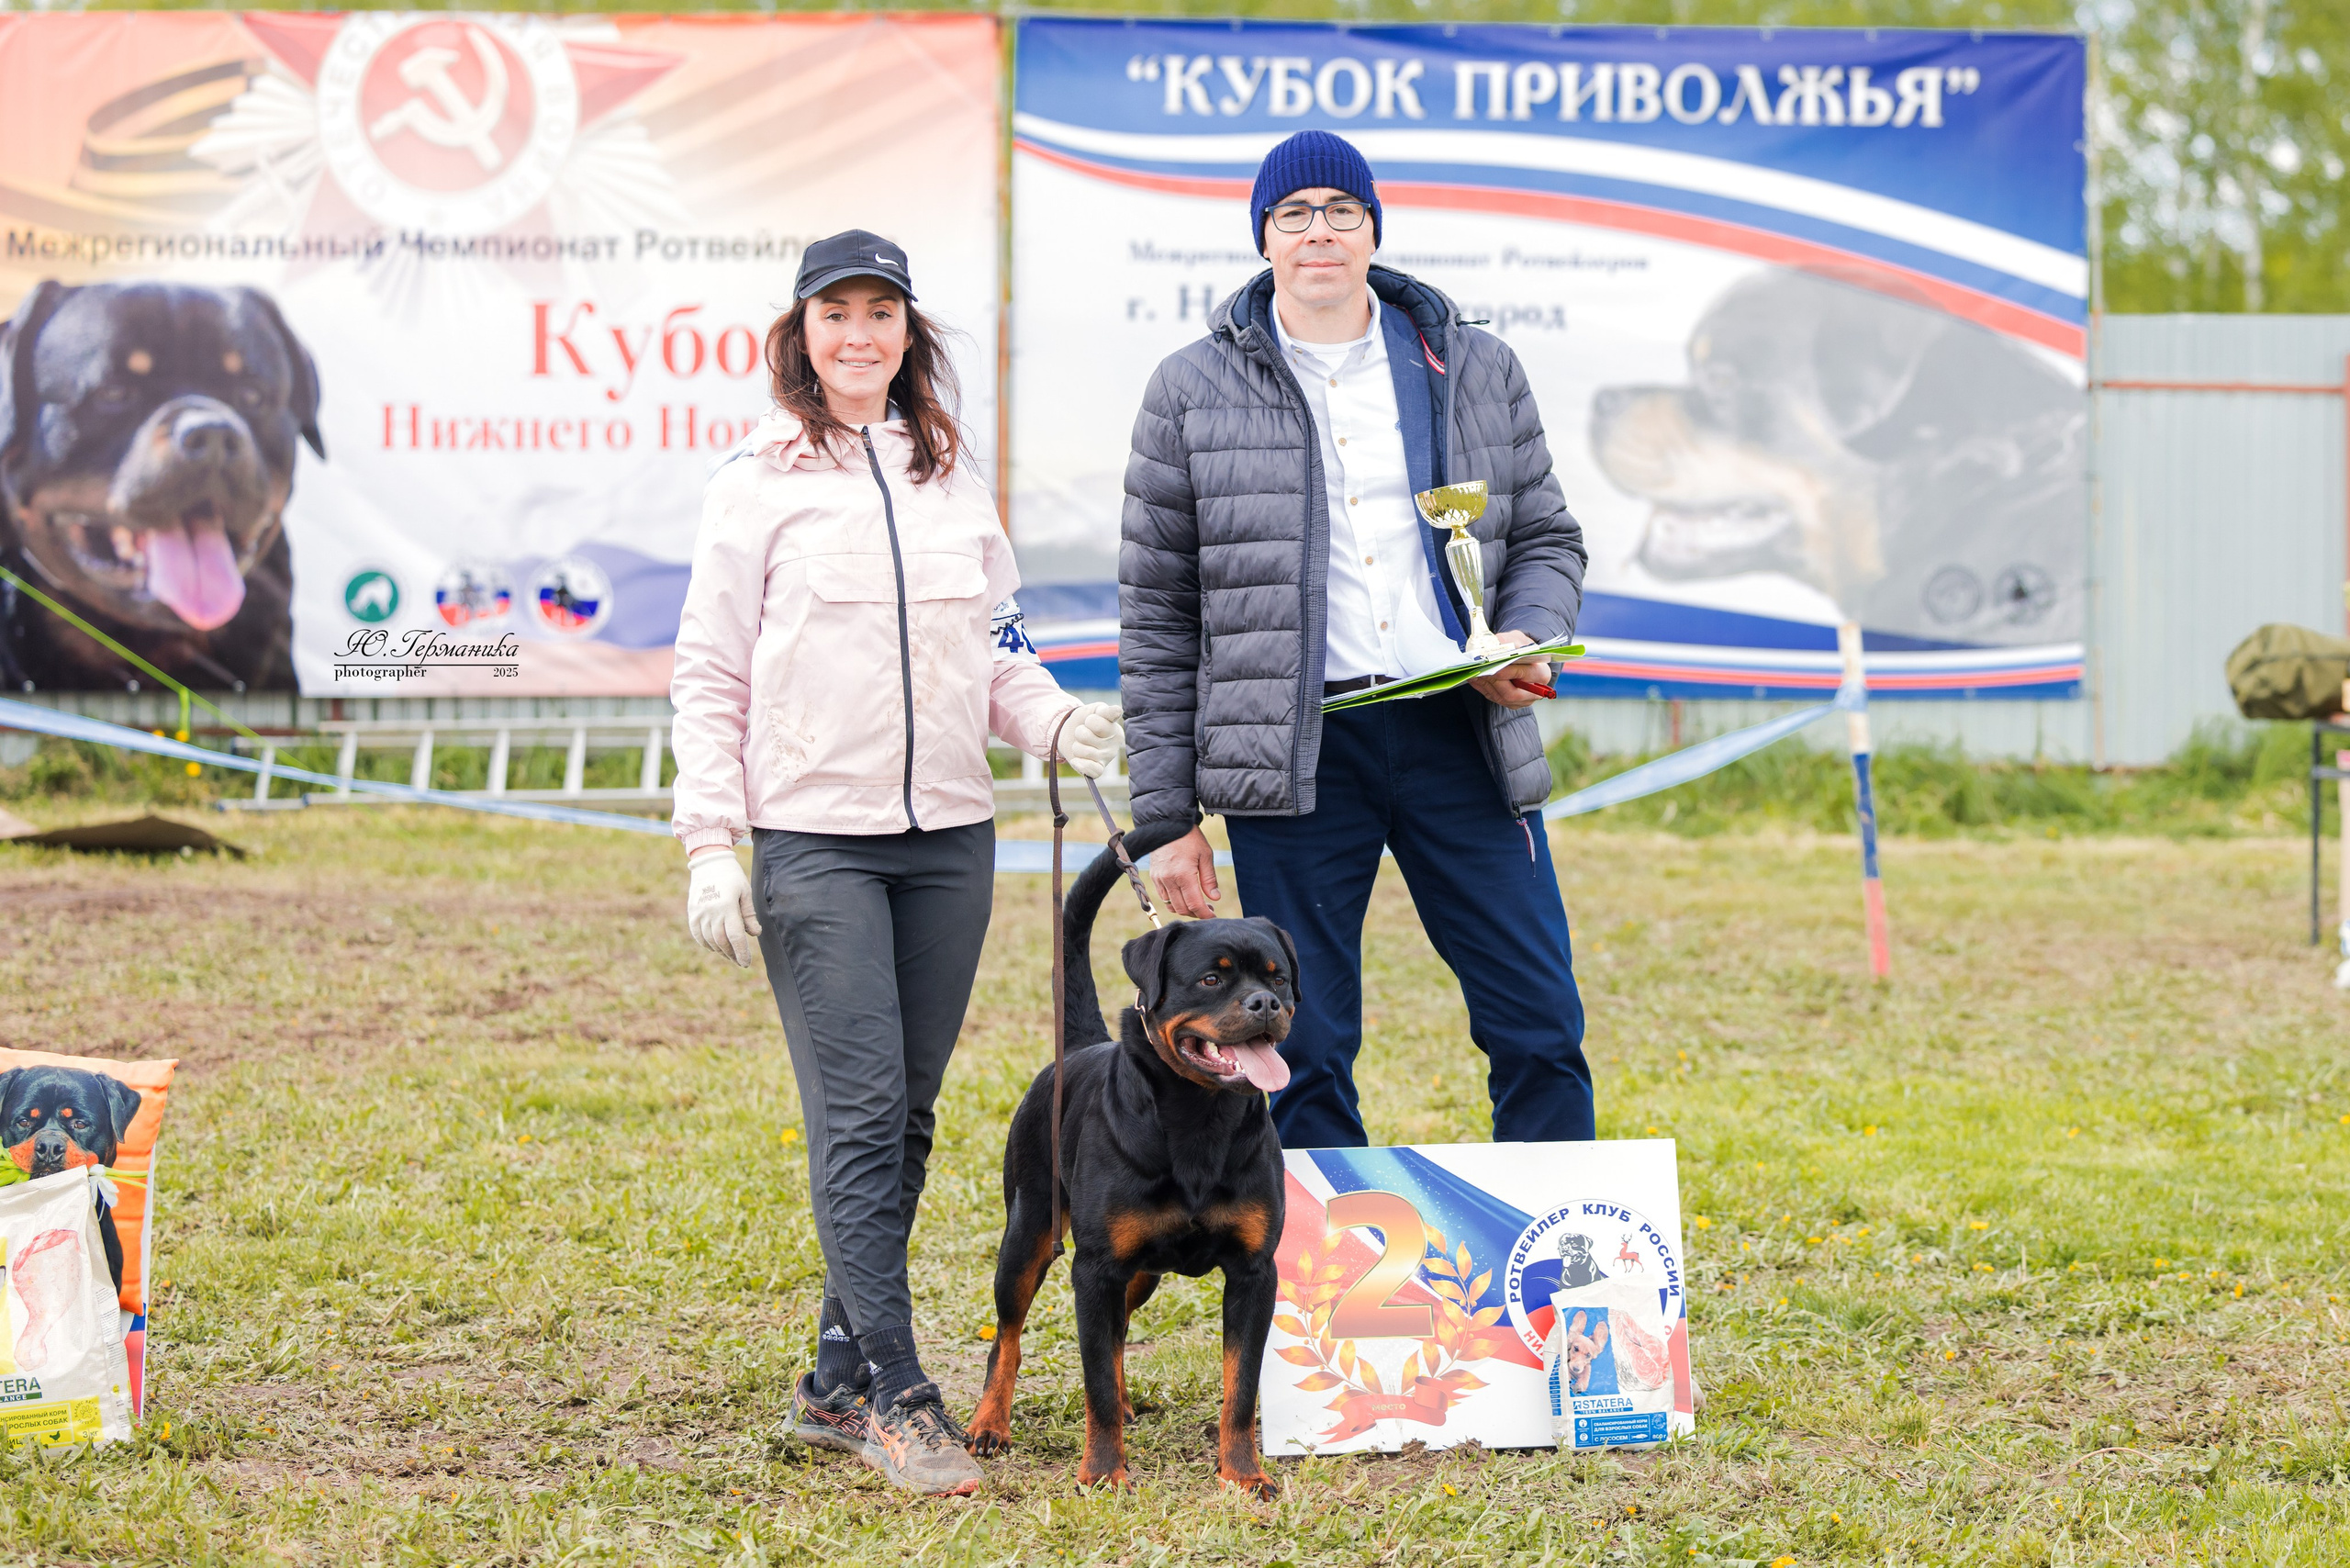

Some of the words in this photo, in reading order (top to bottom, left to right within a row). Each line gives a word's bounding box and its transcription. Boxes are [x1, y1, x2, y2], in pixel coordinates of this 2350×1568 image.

[6, 227, 384, 264] Межрегиональный
[401, 229, 619, 262] Чемпионат
[635, 228, 811, 262] Ротвейл
[1461, 302, 1568, 332] город
[530, 299, 760, 401] Кубо
[382, 404, 633, 450] Нижнего
[1326, 1190, 1435, 1339] 2
[1509, 1208, 1570, 1304] РОТВЕЙЛЕР
[1583, 1204, 1632, 1223] КЛУБ
[1639, 1222, 1680, 1296] РОССИИ
[822, 1334, 850, 1342] adidas
[0, 1377, 41, 1394] ERA
[1583, 1397, 1633, 1408] STATERA
[42, 1417, 68, 1426] СОБАК
